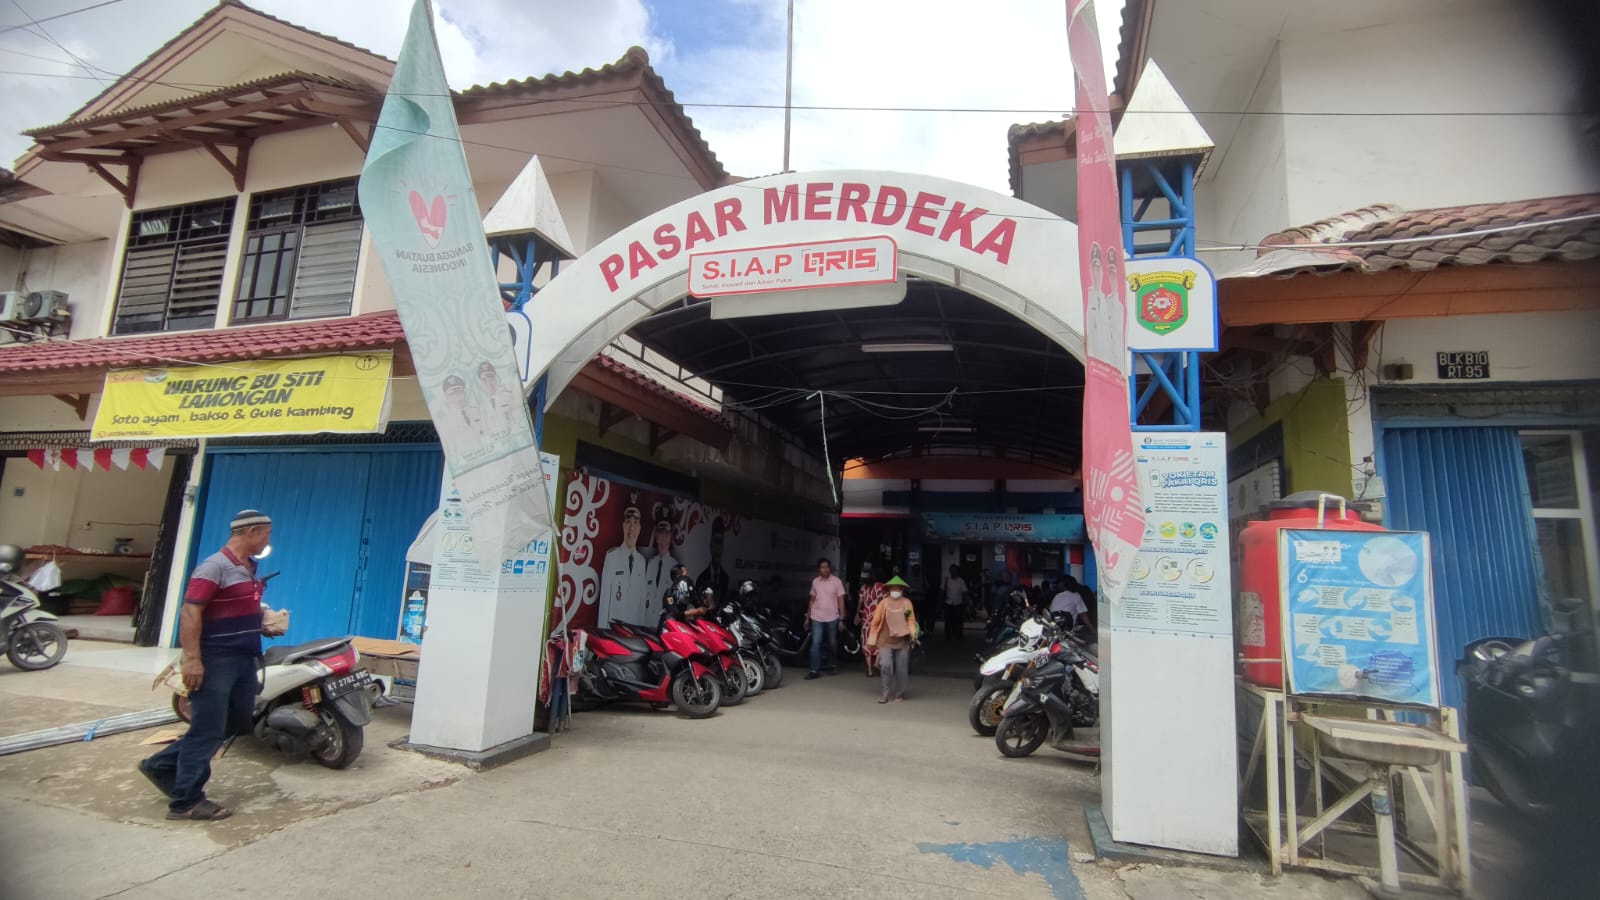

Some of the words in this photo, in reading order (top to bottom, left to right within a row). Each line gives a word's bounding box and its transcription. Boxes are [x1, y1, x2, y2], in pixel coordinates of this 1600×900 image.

[598, 197, 747, 293] PASAR
[763, 182, 1018, 265] MERDEKA
[702, 254, 793, 280] S.I.A.P
[804, 247, 876, 277] QRIS
[1448, 365, 1464, 378] RT
[1465, 365, 1483, 378] 95
[164, 376, 248, 395] WARUNG
[250, 373, 281, 390] BU
[283, 370, 325, 388] SITI
[178, 388, 294, 409] LAMONGAN
[111, 415, 139, 425] Soto
[190, 411, 229, 422] bakso
[233, 409, 245, 420] &
[250, 407, 282, 418] Gule
[286, 404, 355, 420] kambing
[1162, 478, 1192, 488] PAKAI
[1192, 477, 1217, 487] QRIS
[964, 521, 1001, 532] S.I.A.P
[1297, 569, 1308, 583] 6
